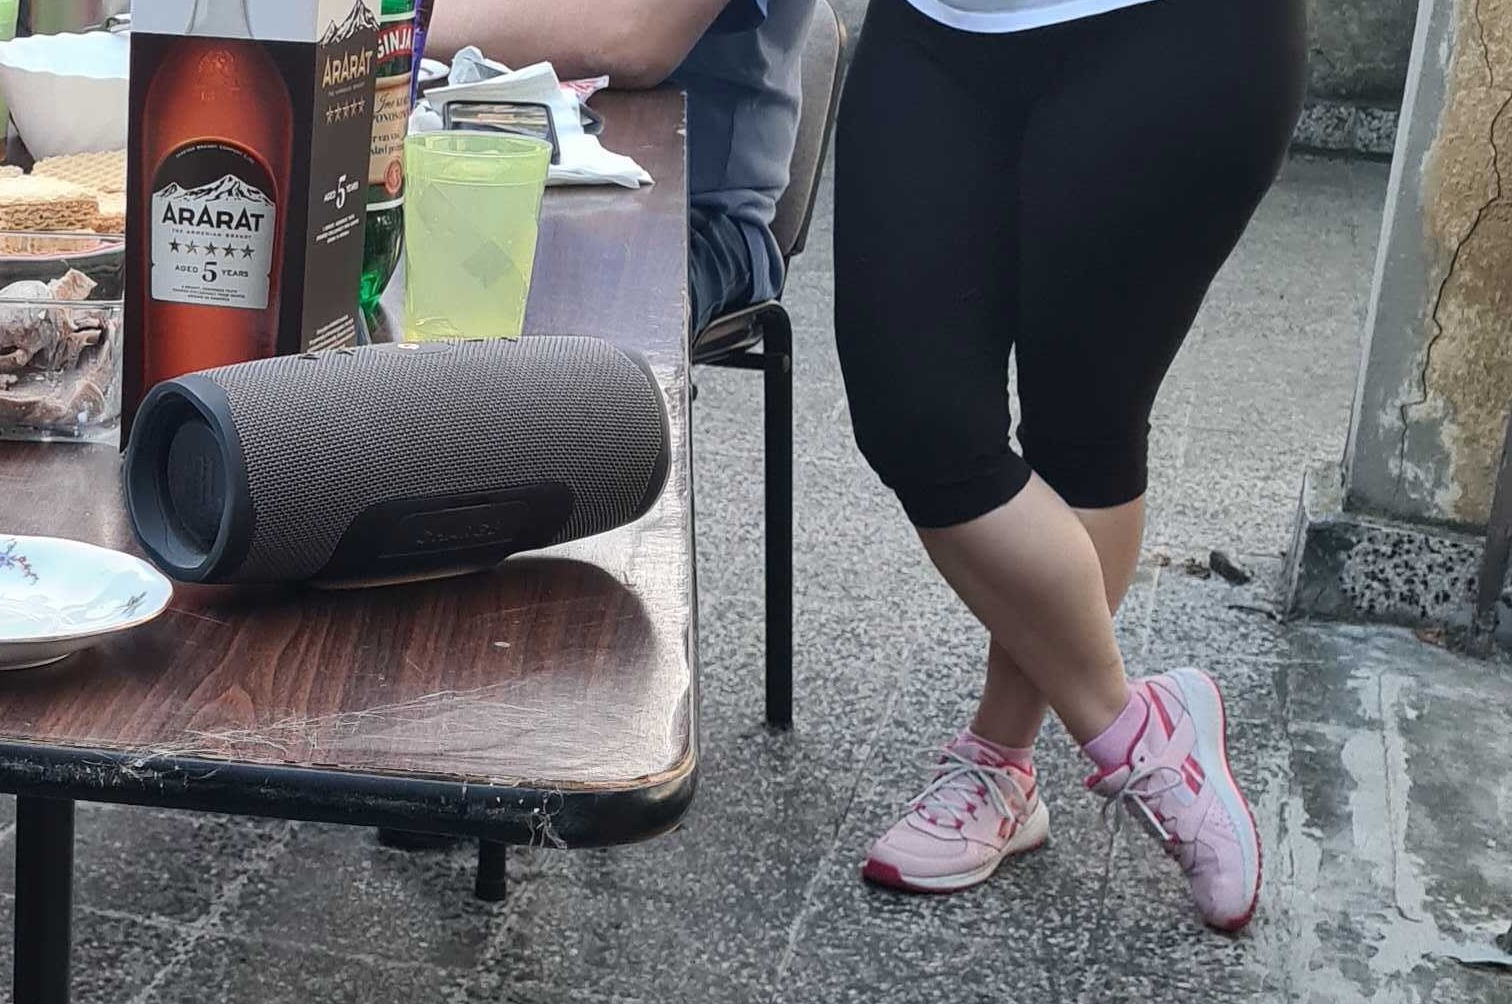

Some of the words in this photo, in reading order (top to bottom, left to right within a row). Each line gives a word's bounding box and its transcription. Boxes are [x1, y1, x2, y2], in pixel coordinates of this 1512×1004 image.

[322, 46, 374, 89] ARARAT
[336, 174, 347, 209] 5
[162, 201, 265, 232] ARARAT
[175, 264, 199, 274] AGED
[202, 262, 218, 283] 5
[221, 269, 249, 278] YEARS
